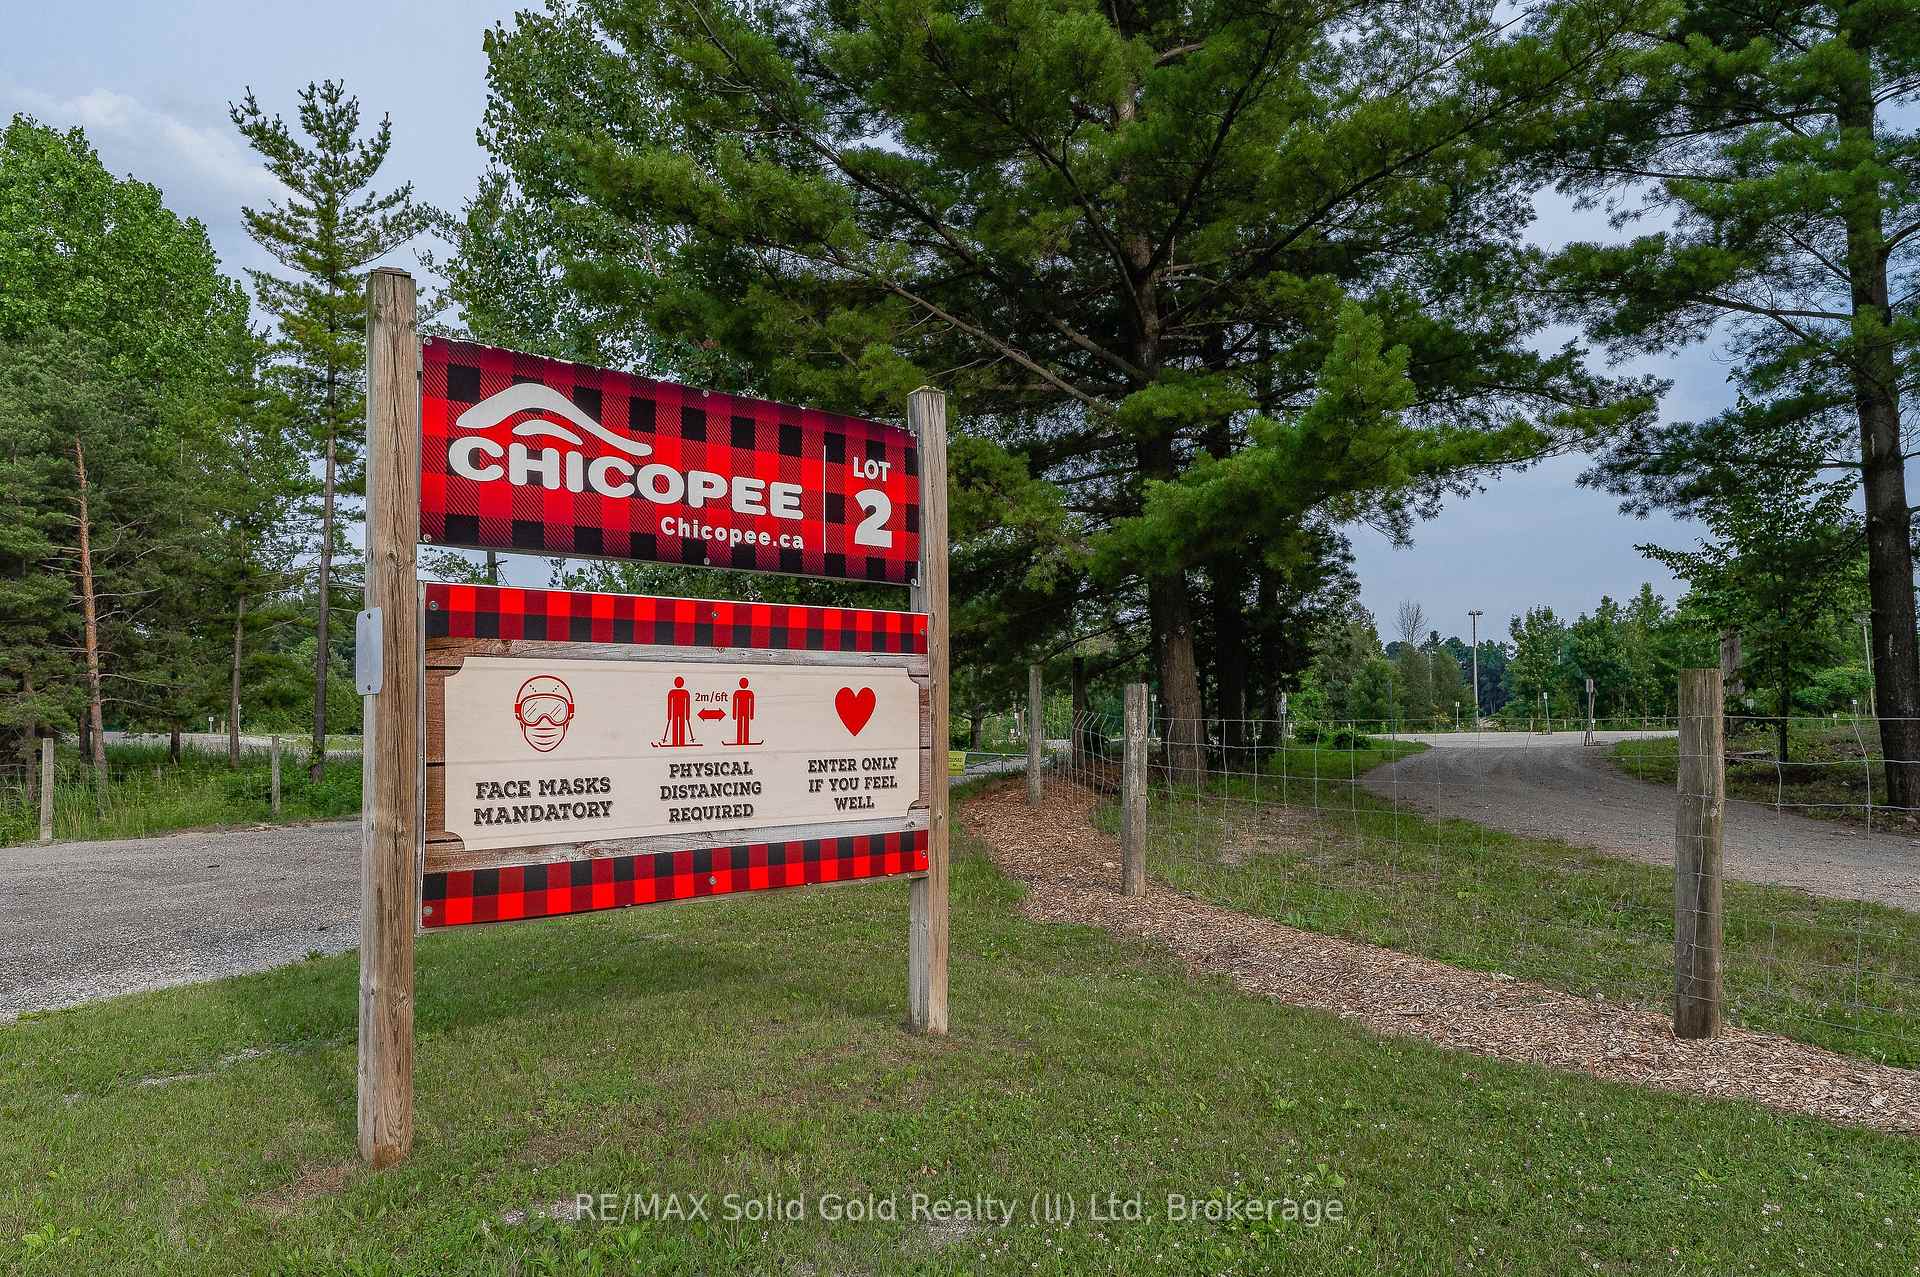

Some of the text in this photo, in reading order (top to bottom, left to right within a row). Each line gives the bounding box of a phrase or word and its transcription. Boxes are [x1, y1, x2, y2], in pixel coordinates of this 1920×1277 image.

[448, 436, 803, 520] CHICOPEE
[853, 457, 891, 482] LOT
[854, 489, 893, 548] 2
[660, 516, 804, 550] Chicopee.ca
[669, 761, 753, 779] PHYSICAL
[807, 756, 898, 773] ENTER ONLY
[475, 776, 612, 800] FACE MASKS
[660, 781, 762, 801] DISTANCING
[808, 775, 898, 793] IF YOU FEEL
[473, 800, 614, 826] MANDATORY
[669, 803, 754, 823] REQUIRED
[834, 795, 875, 811] WELL
